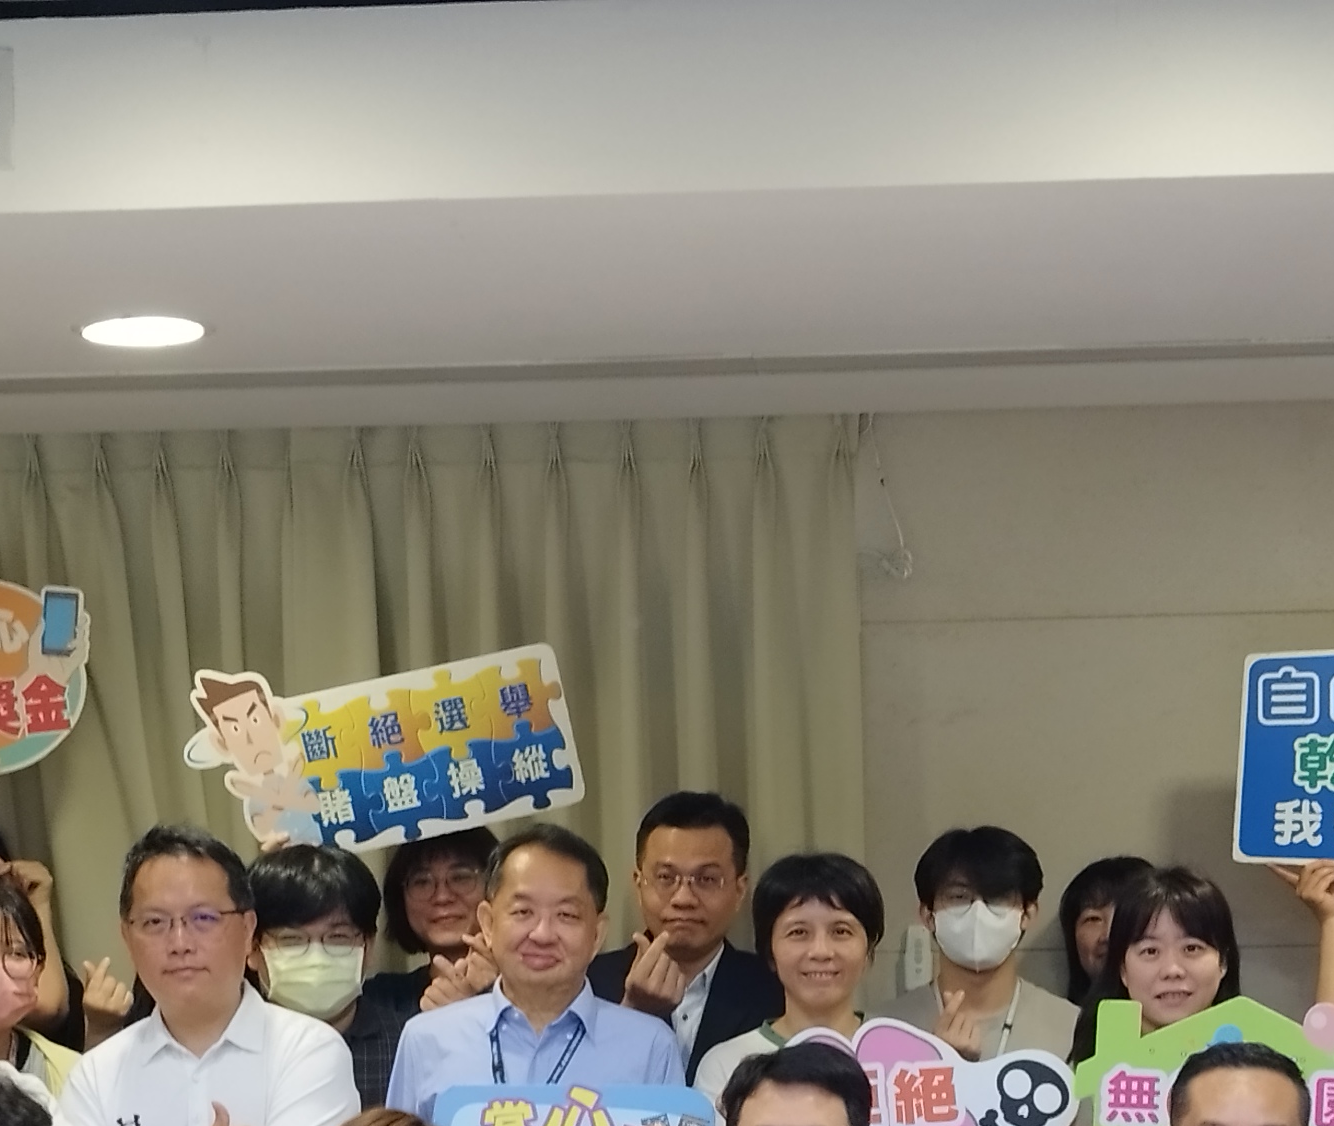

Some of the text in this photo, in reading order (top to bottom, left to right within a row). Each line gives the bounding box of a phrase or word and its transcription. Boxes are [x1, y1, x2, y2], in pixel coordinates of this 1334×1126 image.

[301, 682, 533, 763] 斷絕選舉
[318, 744, 551, 827] 賭盤操縱
[866, 1067, 959, 1126] 絕
